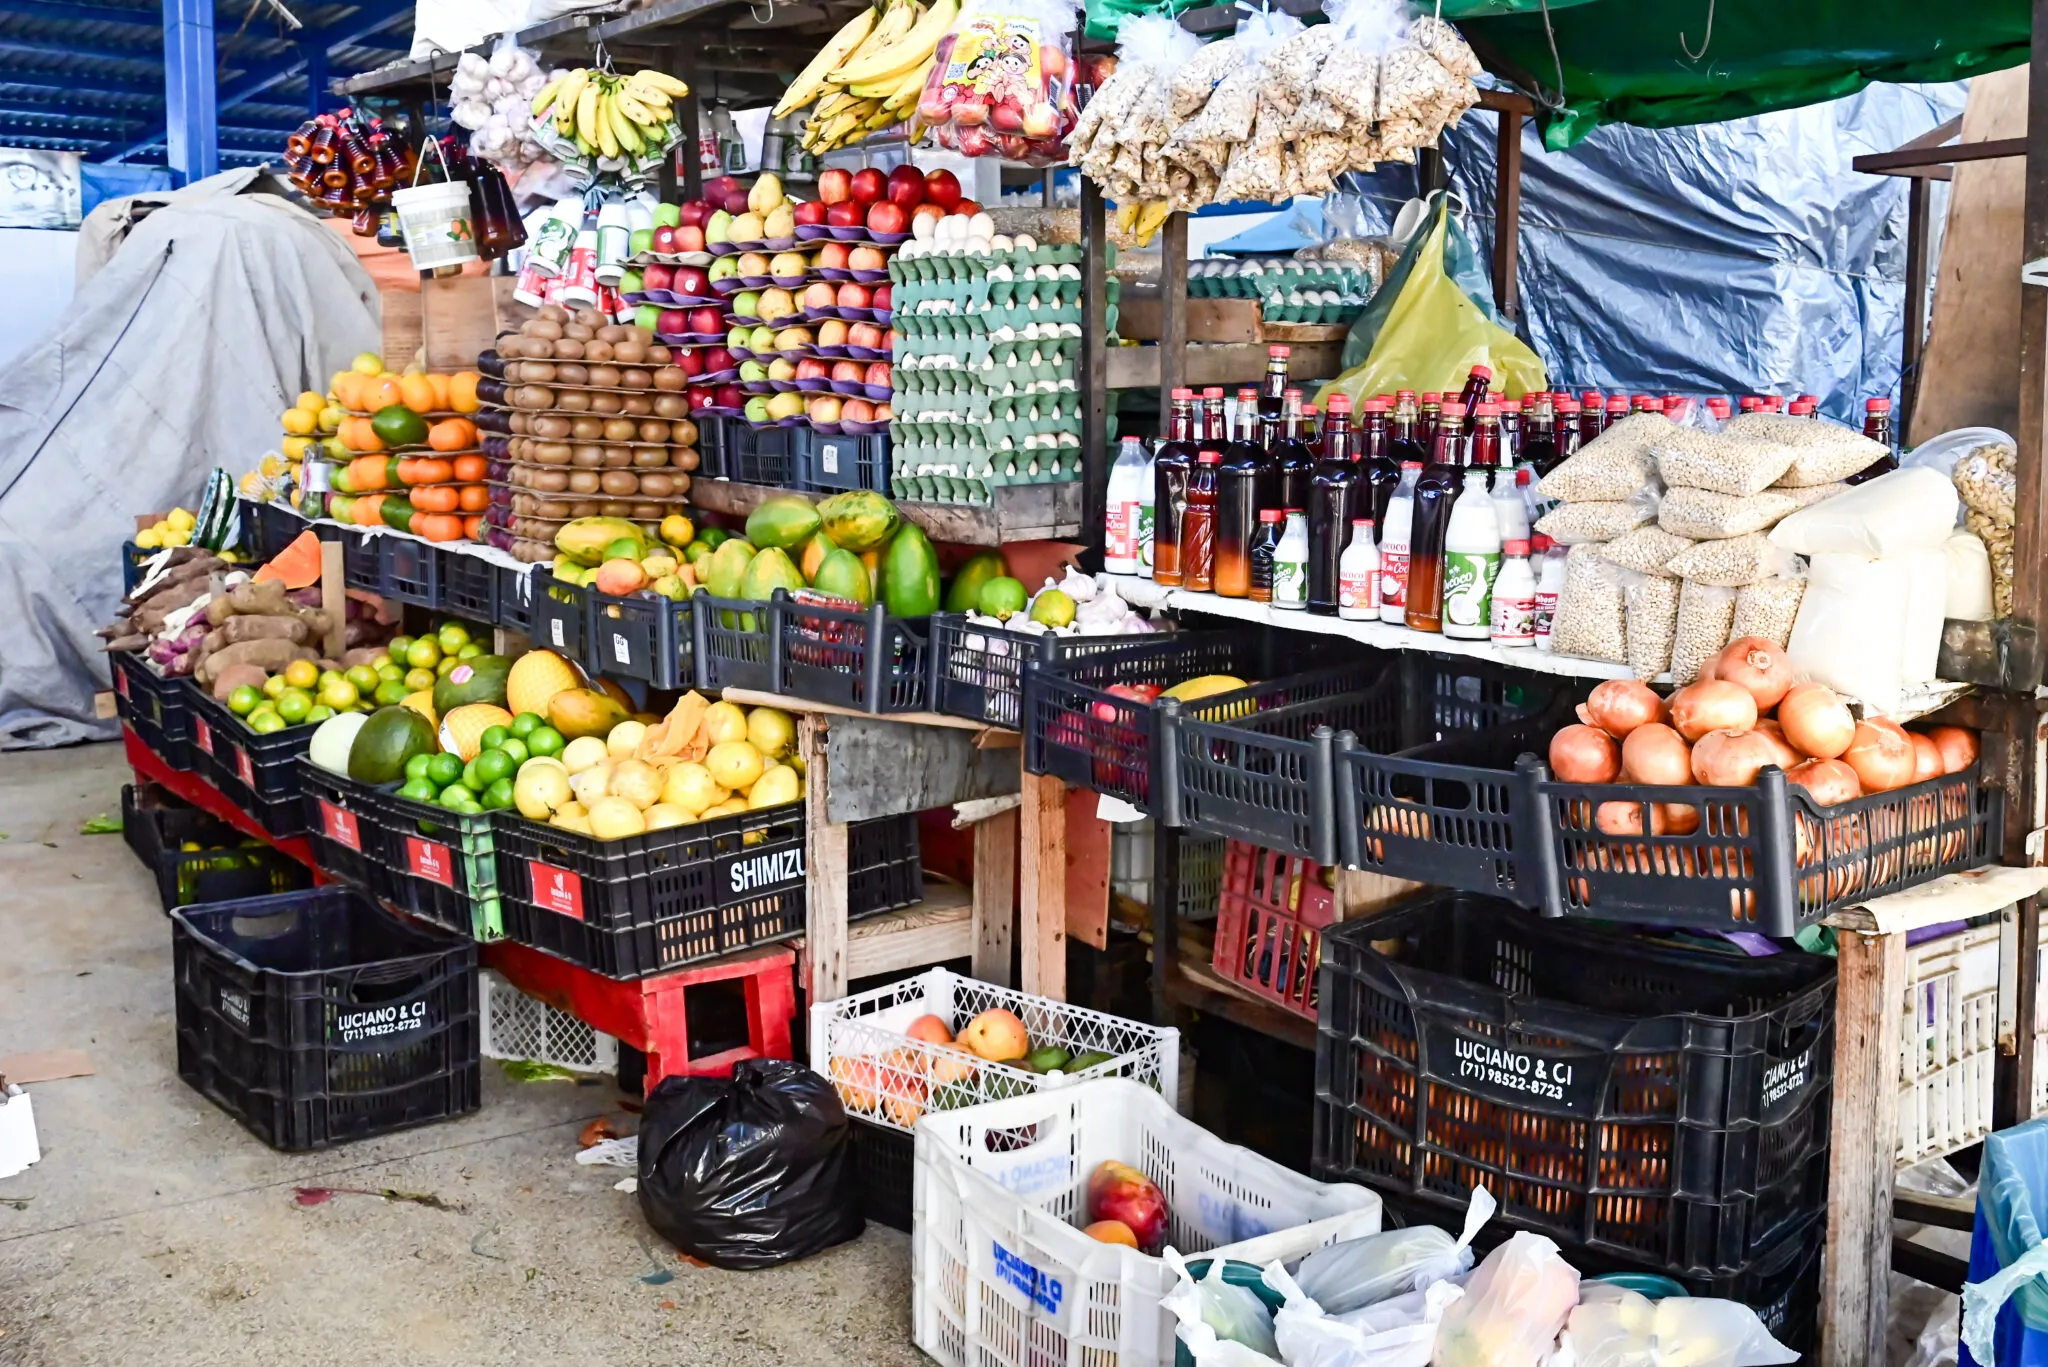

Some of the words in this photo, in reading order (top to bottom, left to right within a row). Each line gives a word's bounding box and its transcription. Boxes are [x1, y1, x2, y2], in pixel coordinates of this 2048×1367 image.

[338, 1007, 397, 1031] LUCIANO
[399, 1005, 409, 1020] &
[411, 1001, 426, 1017] CI
[343, 1028, 364, 1043] (71)
[364, 1018, 422, 1037] 98522-8723
[1455, 1038, 1531, 1075] LUCIANO
[1535, 1058, 1548, 1080] &
[1552, 1062, 1572, 1086] CI
[1763, 1061, 1790, 1091] CIANO
[1460, 1059, 1486, 1081] (71)
[1487, 1068, 1563, 1100] 98522-8723
